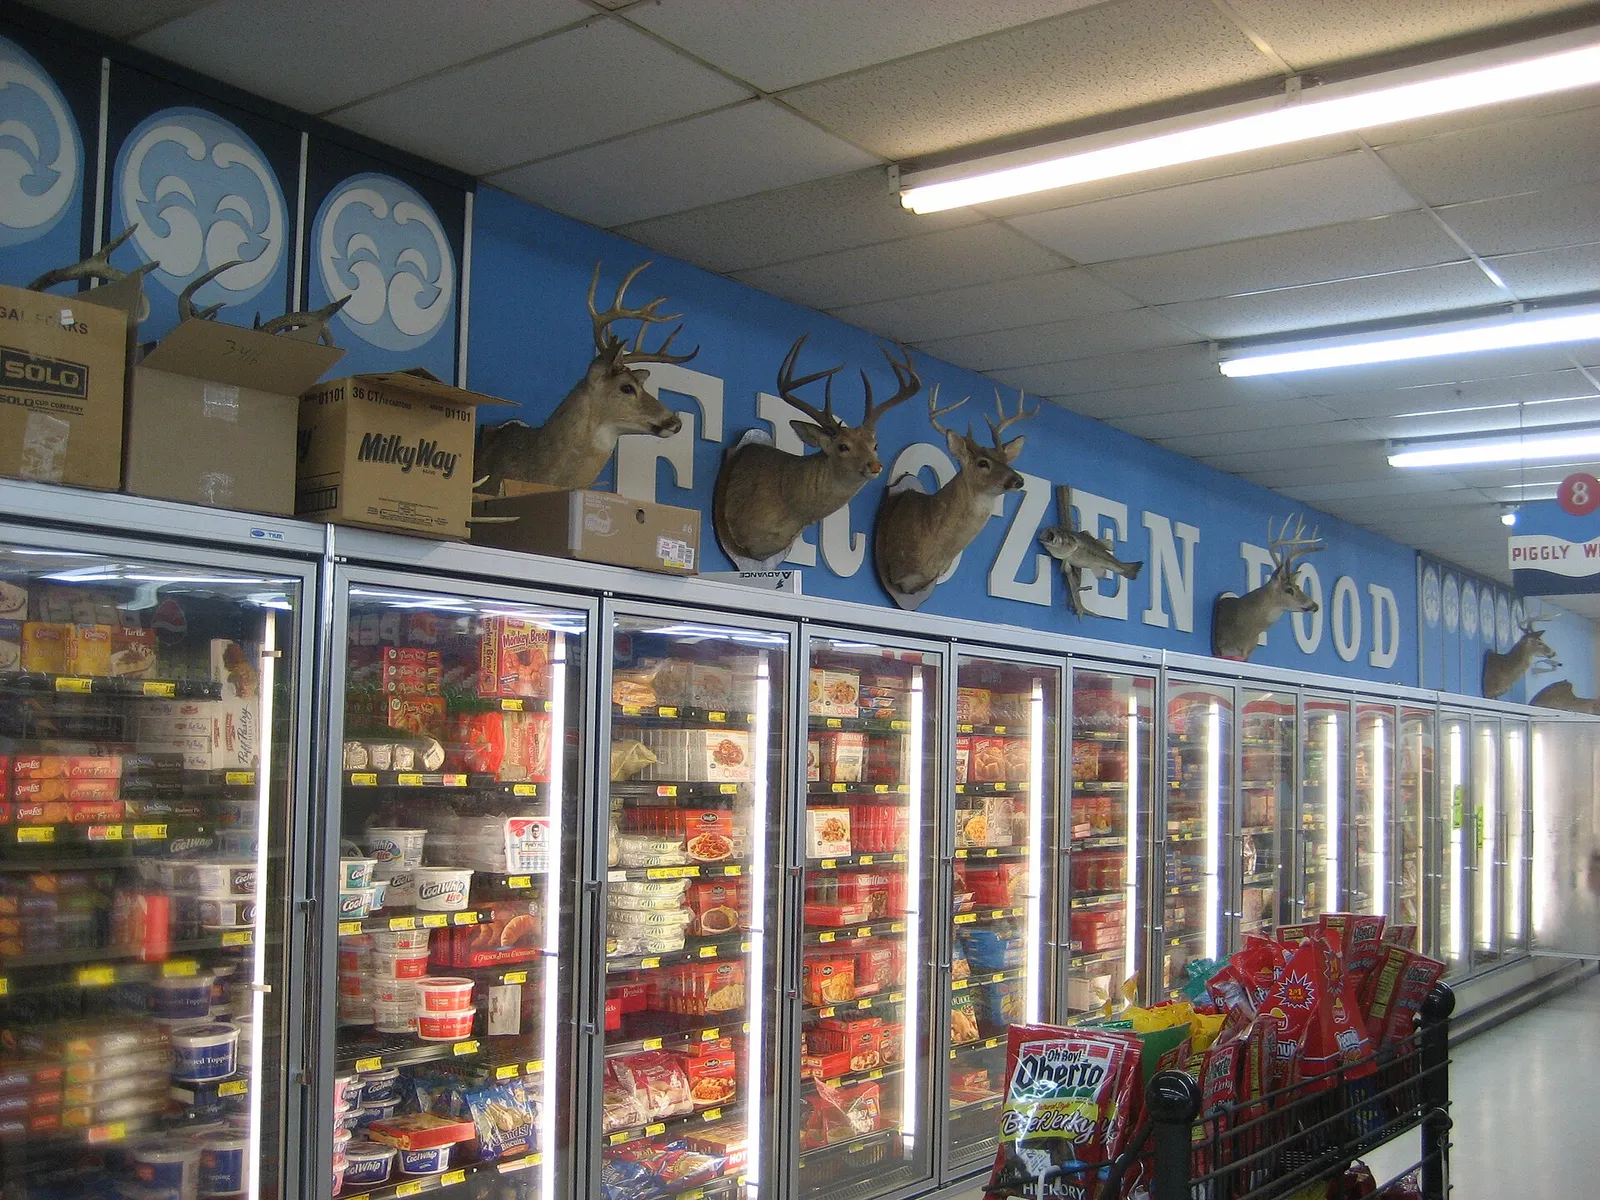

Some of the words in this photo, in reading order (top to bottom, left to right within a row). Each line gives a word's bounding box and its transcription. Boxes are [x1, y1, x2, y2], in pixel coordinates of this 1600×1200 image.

[5, 361, 80, 388] SOLO
[318, 387, 345, 405] 01101
[352, 387, 364, 399] 36
[50, 402, 84, 412] COMPANY
[445, 407, 471, 422] 01101
[1572, 482, 1589, 505] 8
[1512, 545, 1570, 561] PIGGLY
[123, 627, 147, 637] Turtle
[502, 631, 529, 648] Monkey
[531, 629, 549, 643] Bread
[237, 703, 253, 740] Pastry
[375, 850, 390, 860] Lite
[445, 894, 460, 903] Lite
[1047, 1049, 1060, 1062] Oh
[1062, 1050, 1082, 1063] Boy!
[1015, 1054, 1104, 1091] Oberto
[501, 1138, 526, 1151] Biscuits
